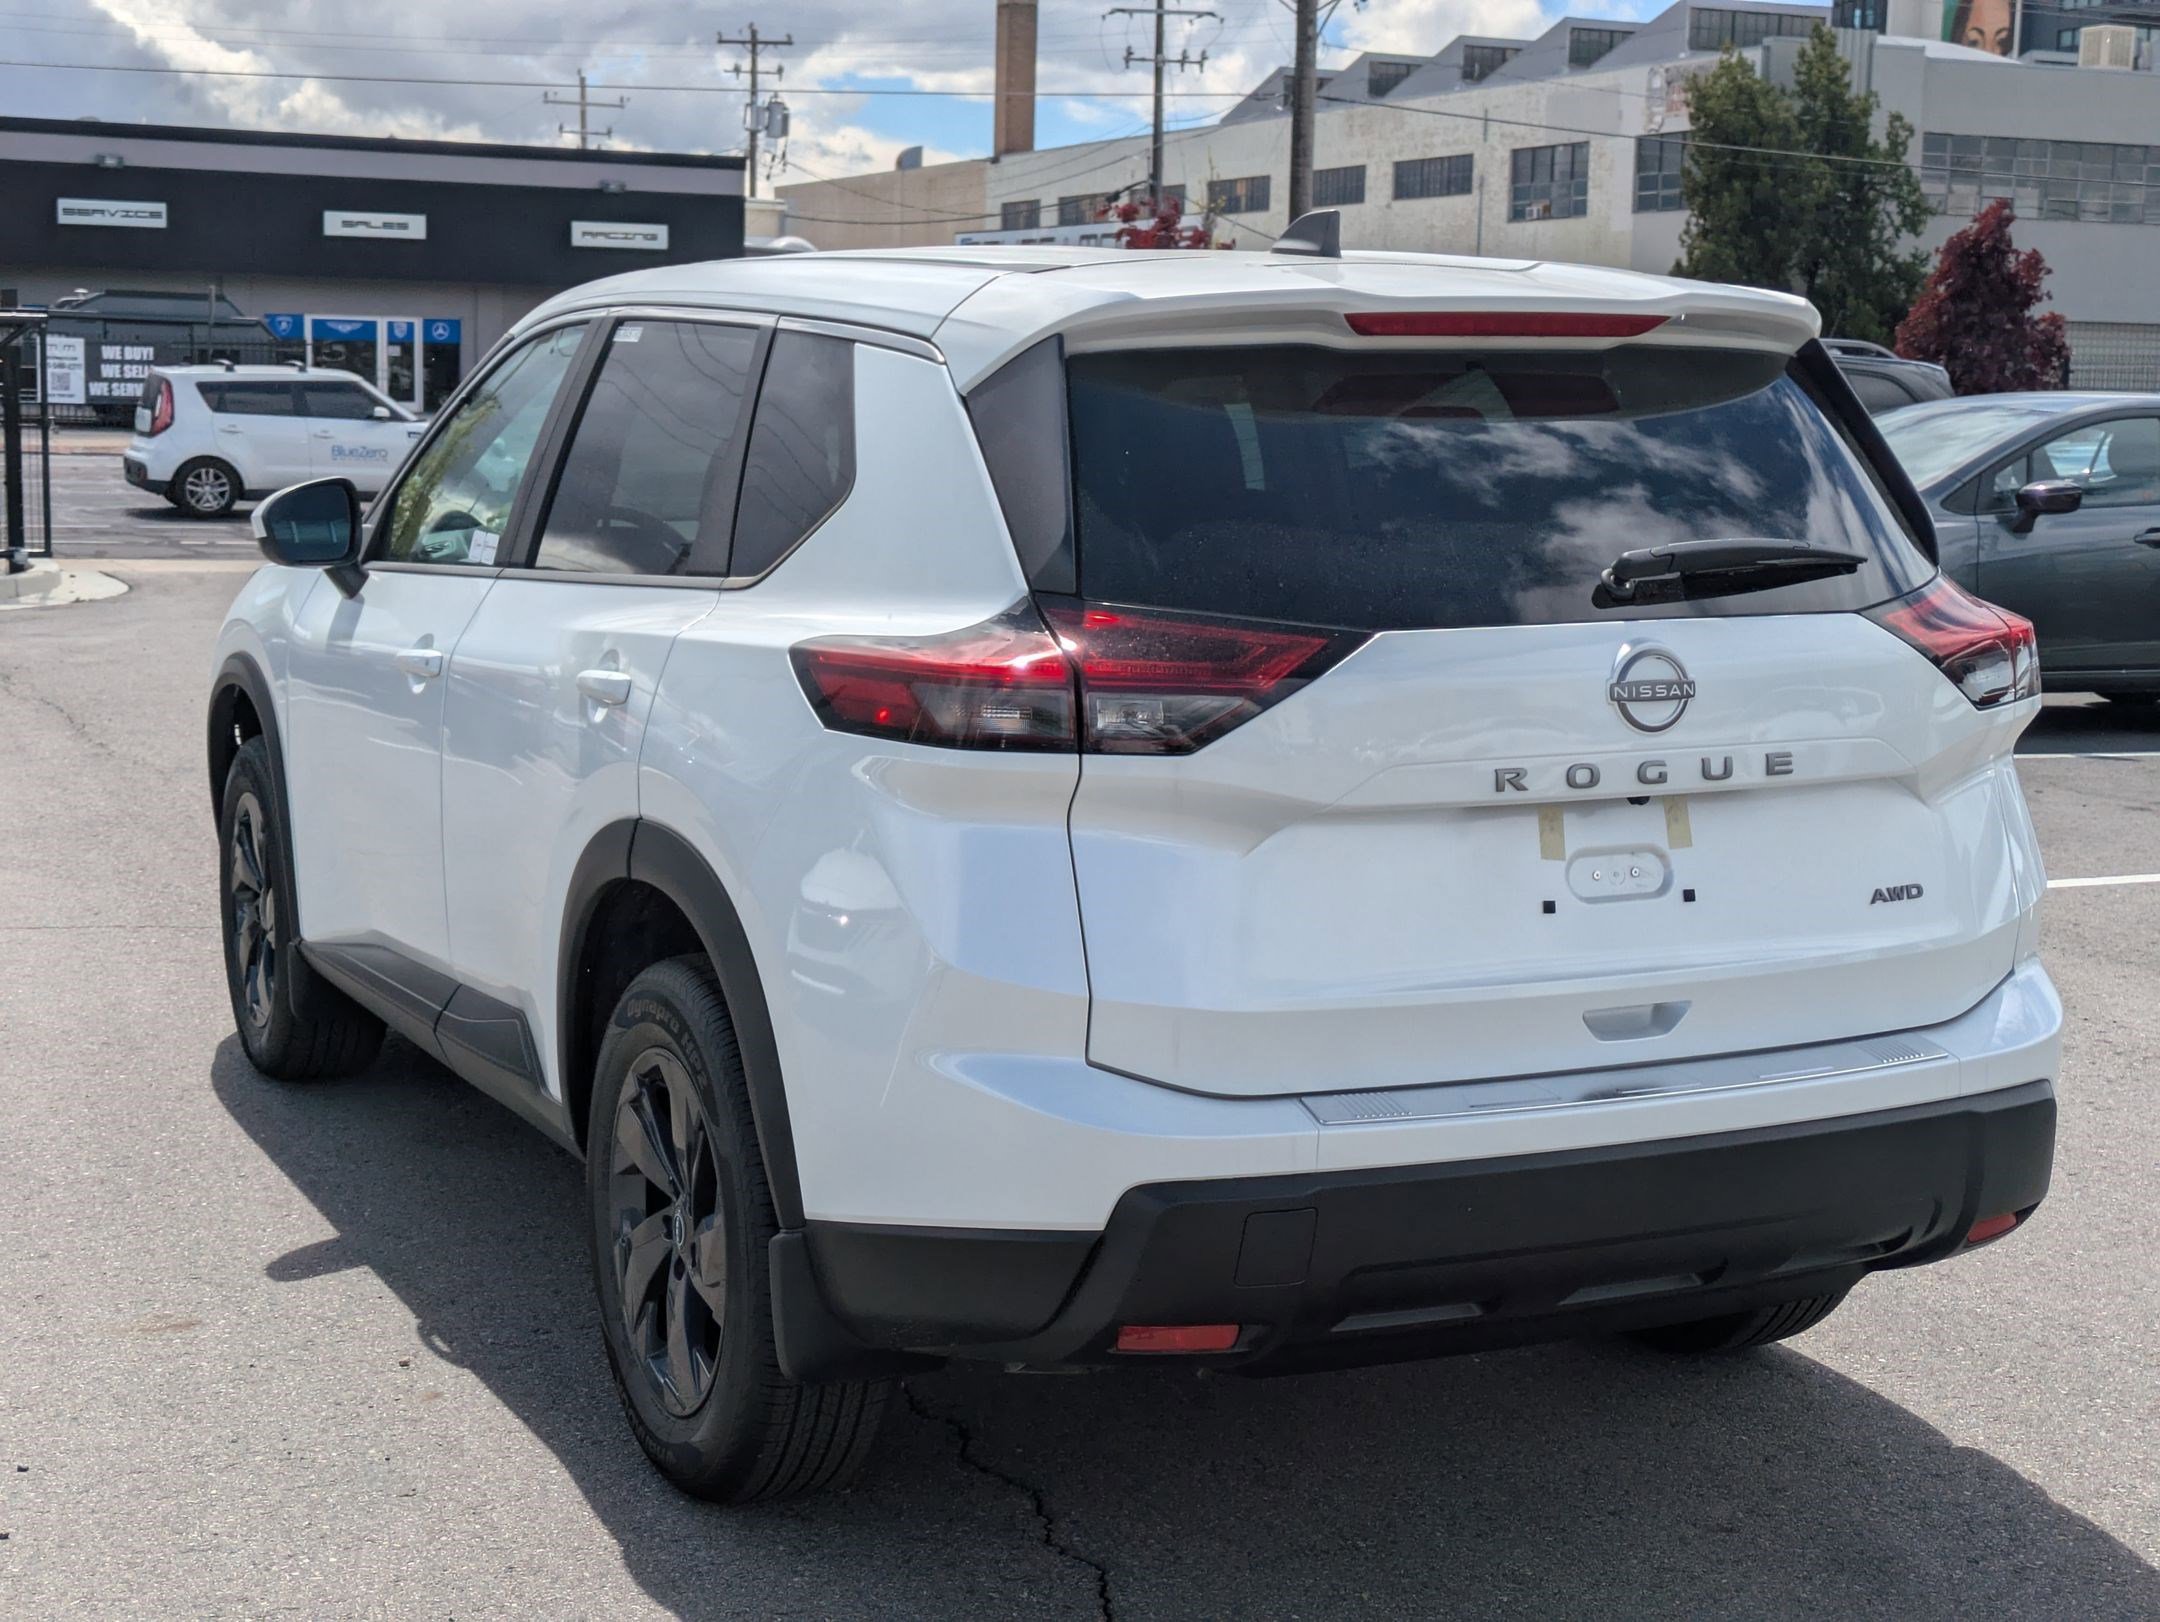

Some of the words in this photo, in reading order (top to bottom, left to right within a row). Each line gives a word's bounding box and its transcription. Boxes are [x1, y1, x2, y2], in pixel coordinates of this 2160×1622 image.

[62, 207, 163, 219] SERVICE
[341, 220, 410, 231] SALES
[581, 231, 659, 242] RACING
[101, 345, 122, 360] WE
[123, 346, 154, 361] BUY!
[100, 364, 122, 378] WE
[123, 364, 149, 379] SELL
[88, 382, 110, 396] WE
[331, 445, 388, 458] BlueZero
[1613, 681, 1696, 699] NISSAN
[1494, 751, 1794, 793] ROGUE
[1869, 883, 1924, 905] AWD
